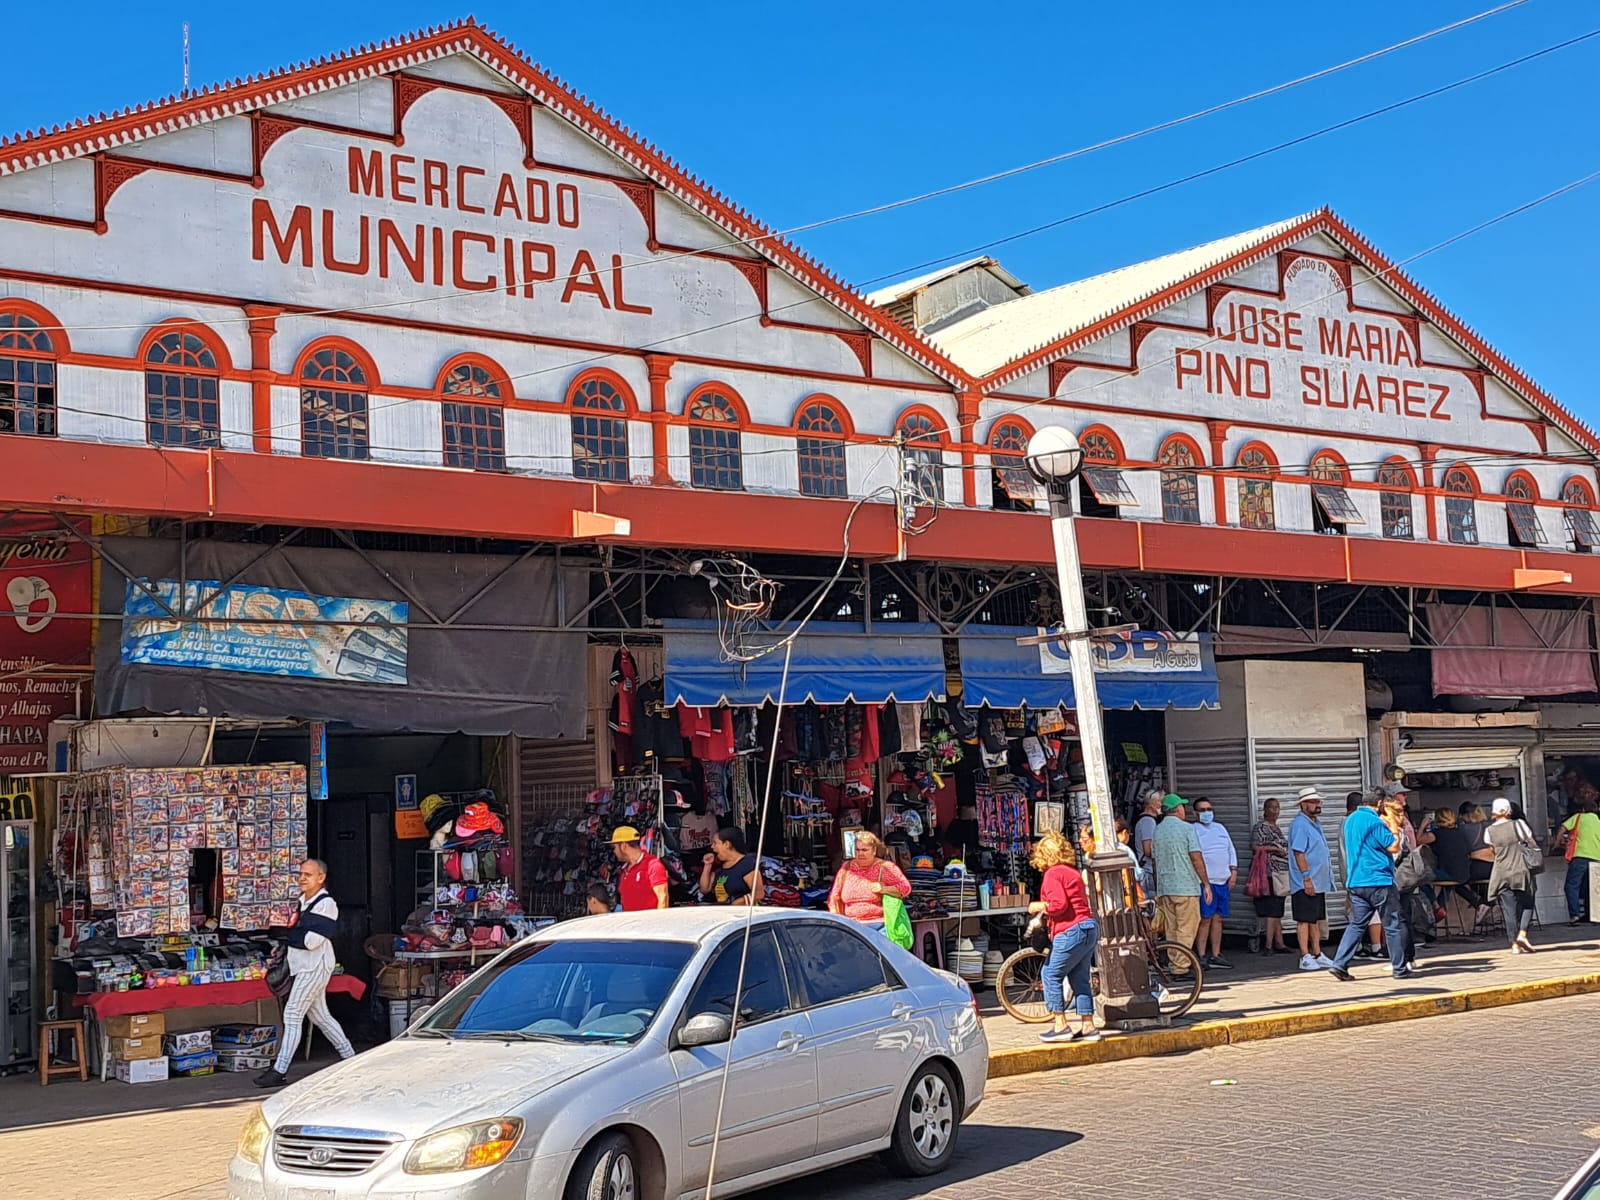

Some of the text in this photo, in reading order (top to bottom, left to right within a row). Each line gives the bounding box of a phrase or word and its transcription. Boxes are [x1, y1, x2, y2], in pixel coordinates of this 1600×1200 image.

[348, 146, 579, 229] MERCADO
[252, 198, 652, 315] MUNICIPAL
[1286, 258, 1315, 282] FUNDADO
[1318, 261, 1327, 273] EN
[1217, 302, 1417, 368] JOSE MARIA
[1175, 348, 1451, 420] PINO SUAREZ
[1167, 650, 1198, 667] Gusto
[9, 700, 52, 719] Alhajas
[20, 752, 30, 767] el
